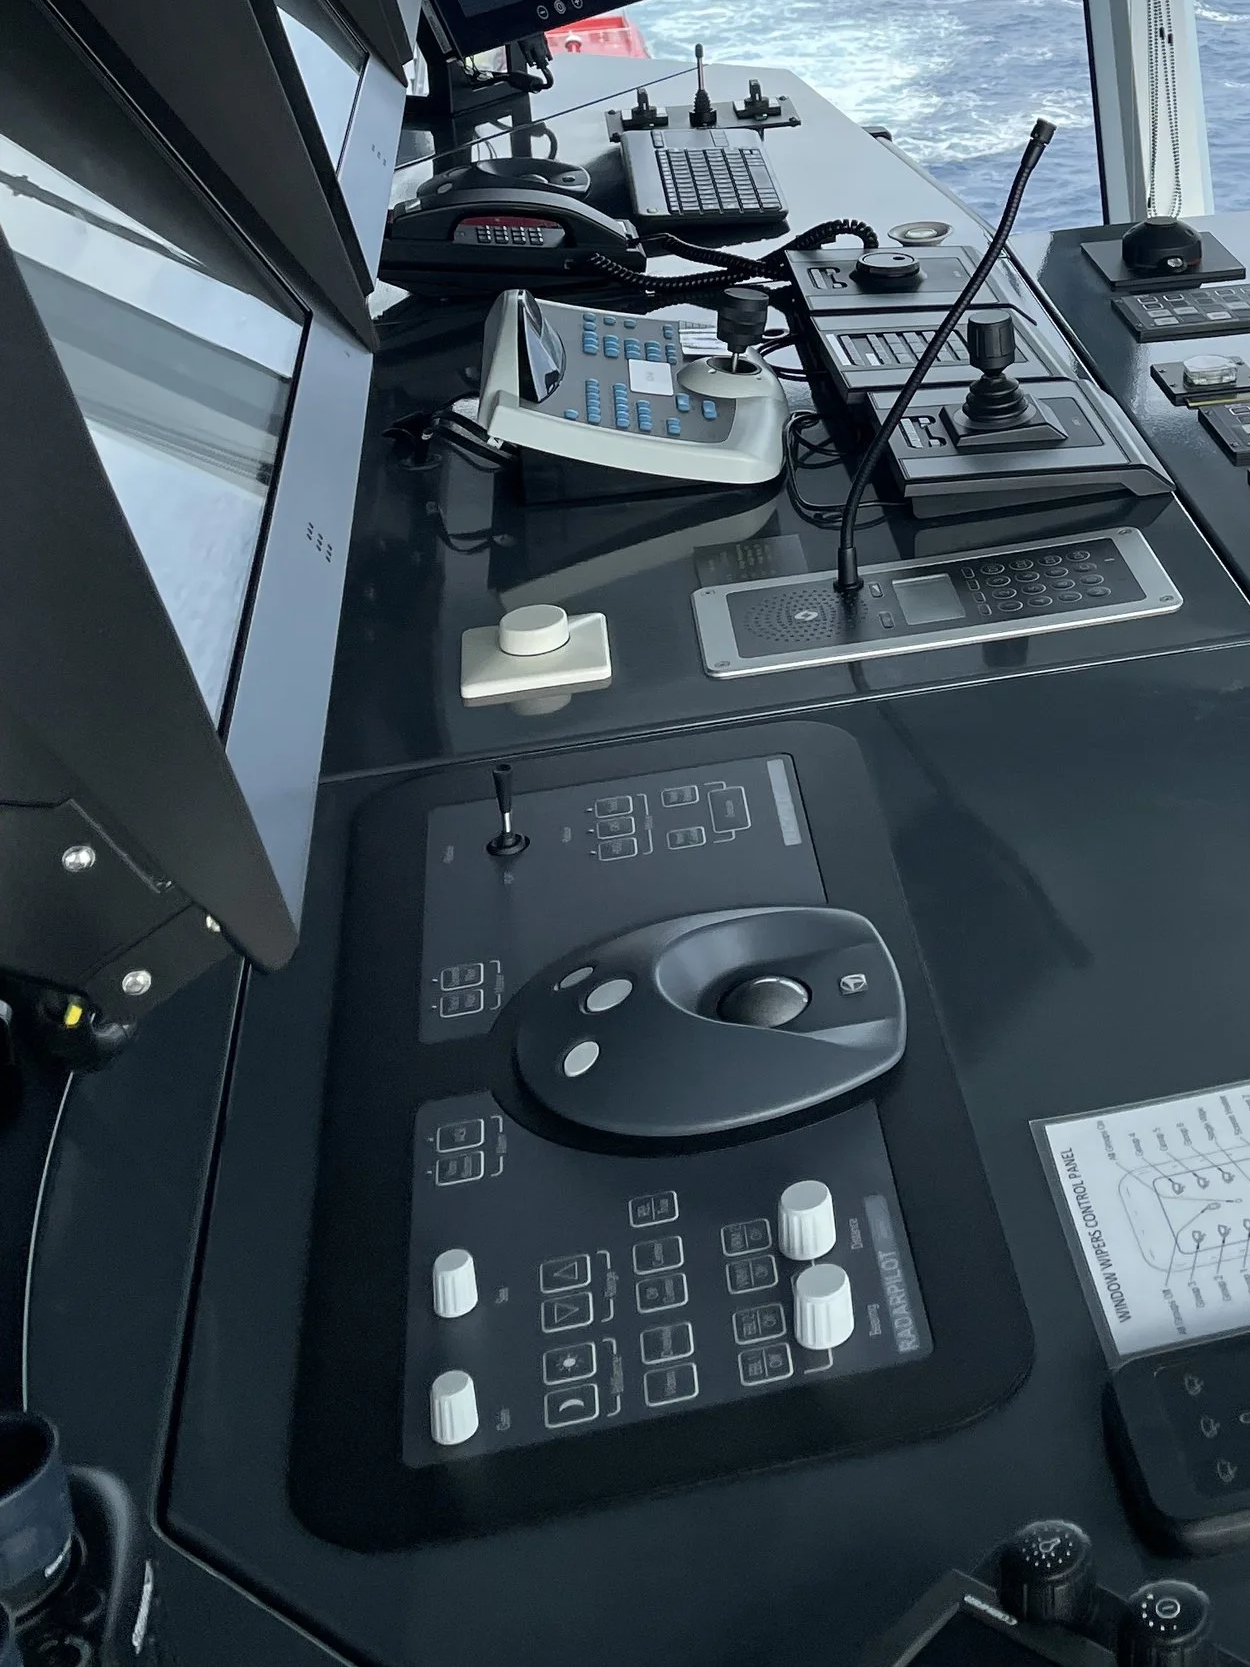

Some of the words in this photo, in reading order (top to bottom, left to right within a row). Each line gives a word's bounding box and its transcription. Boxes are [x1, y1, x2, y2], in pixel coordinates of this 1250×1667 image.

[1059, 1147, 1081, 1179] PANEL
[1070, 1180, 1099, 1229] CONTROL
[1087, 1229, 1113, 1271] WIPERS
[878, 1250, 919, 1353] RADARPILOT
[1102, 1270, 1132, 1323] WINDOW
